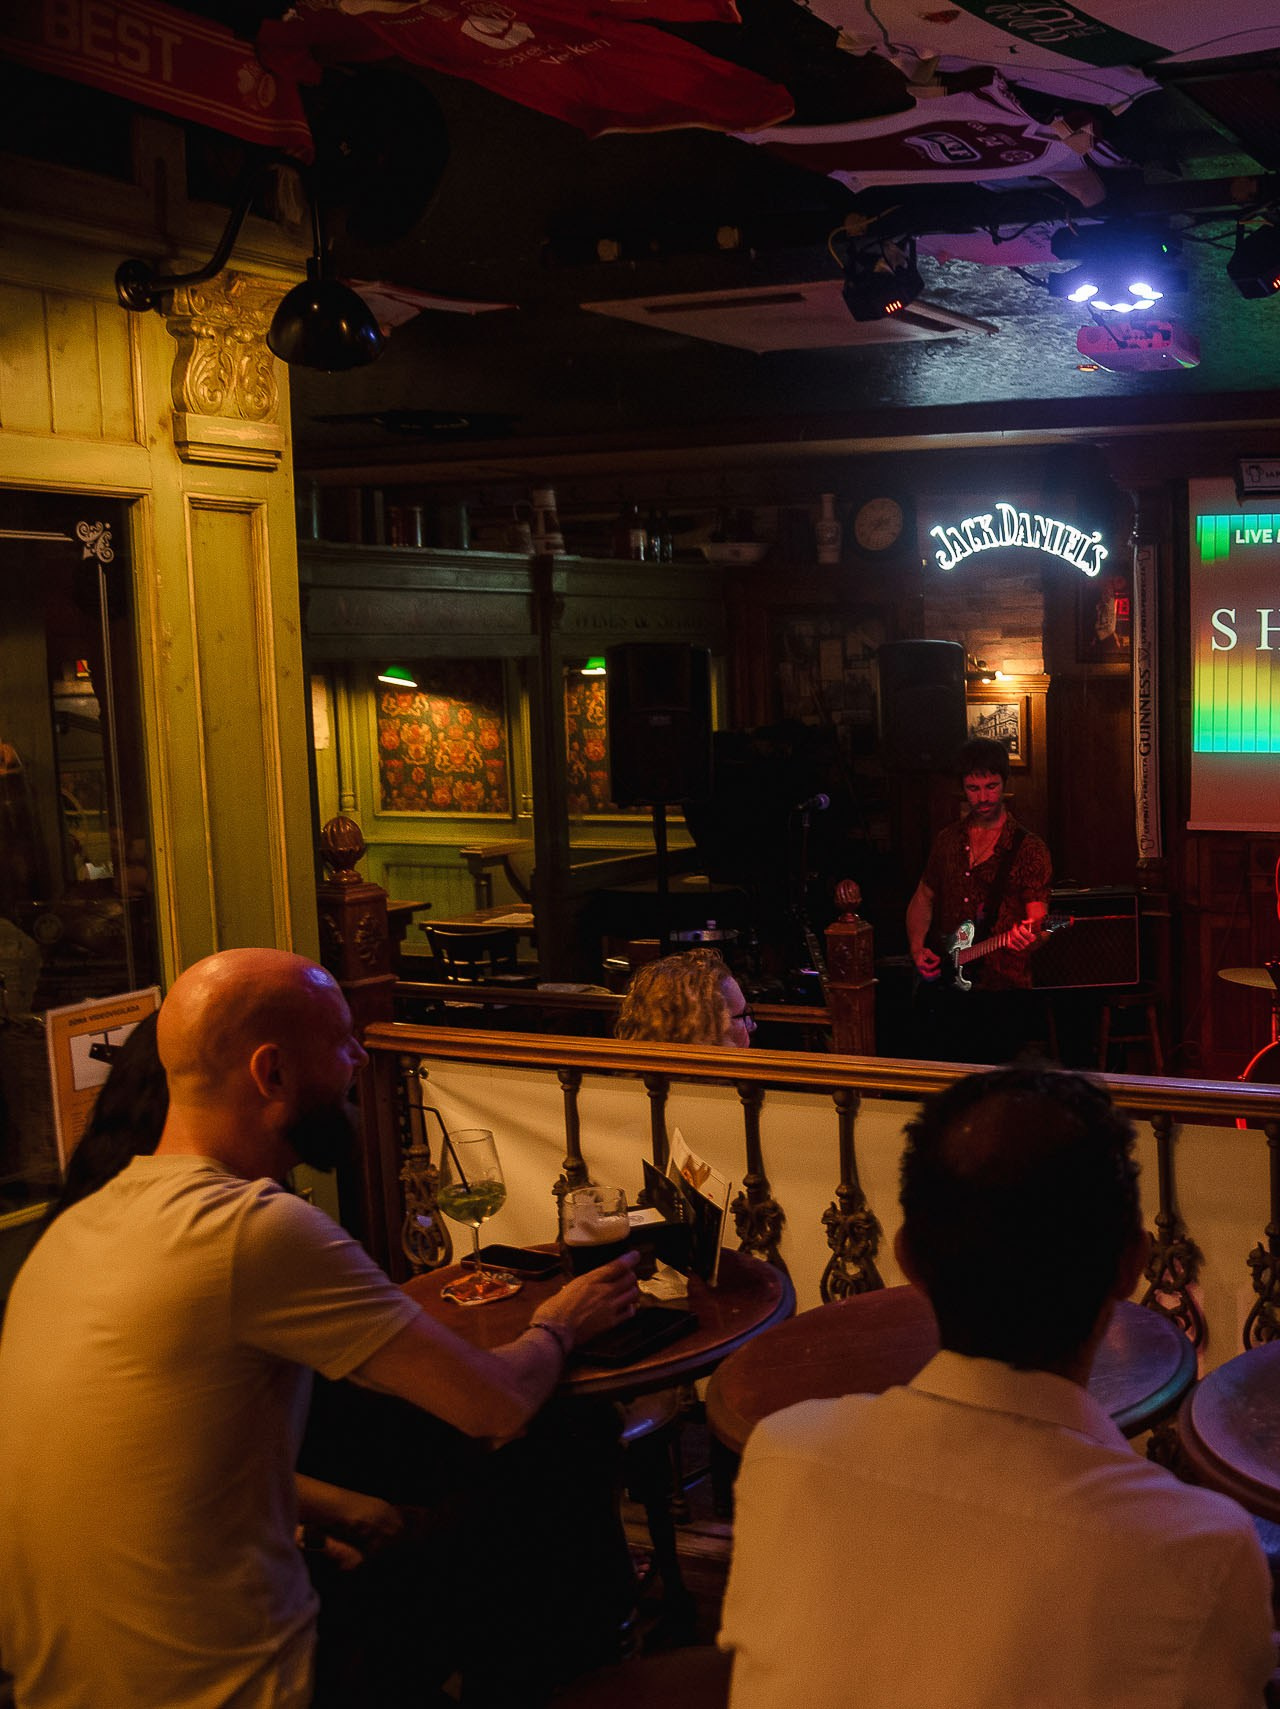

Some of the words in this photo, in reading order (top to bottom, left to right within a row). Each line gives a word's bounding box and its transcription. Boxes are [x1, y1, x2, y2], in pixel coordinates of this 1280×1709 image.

[47, 0, 183, 82] BEST
[930, 513, 1000, 571] JACK
[995, 502, 1109, 578] DANIEL'S
[1235, 529, 1273, 544] LIVE
[1139, 668, 1151, 756] GUINNESS
